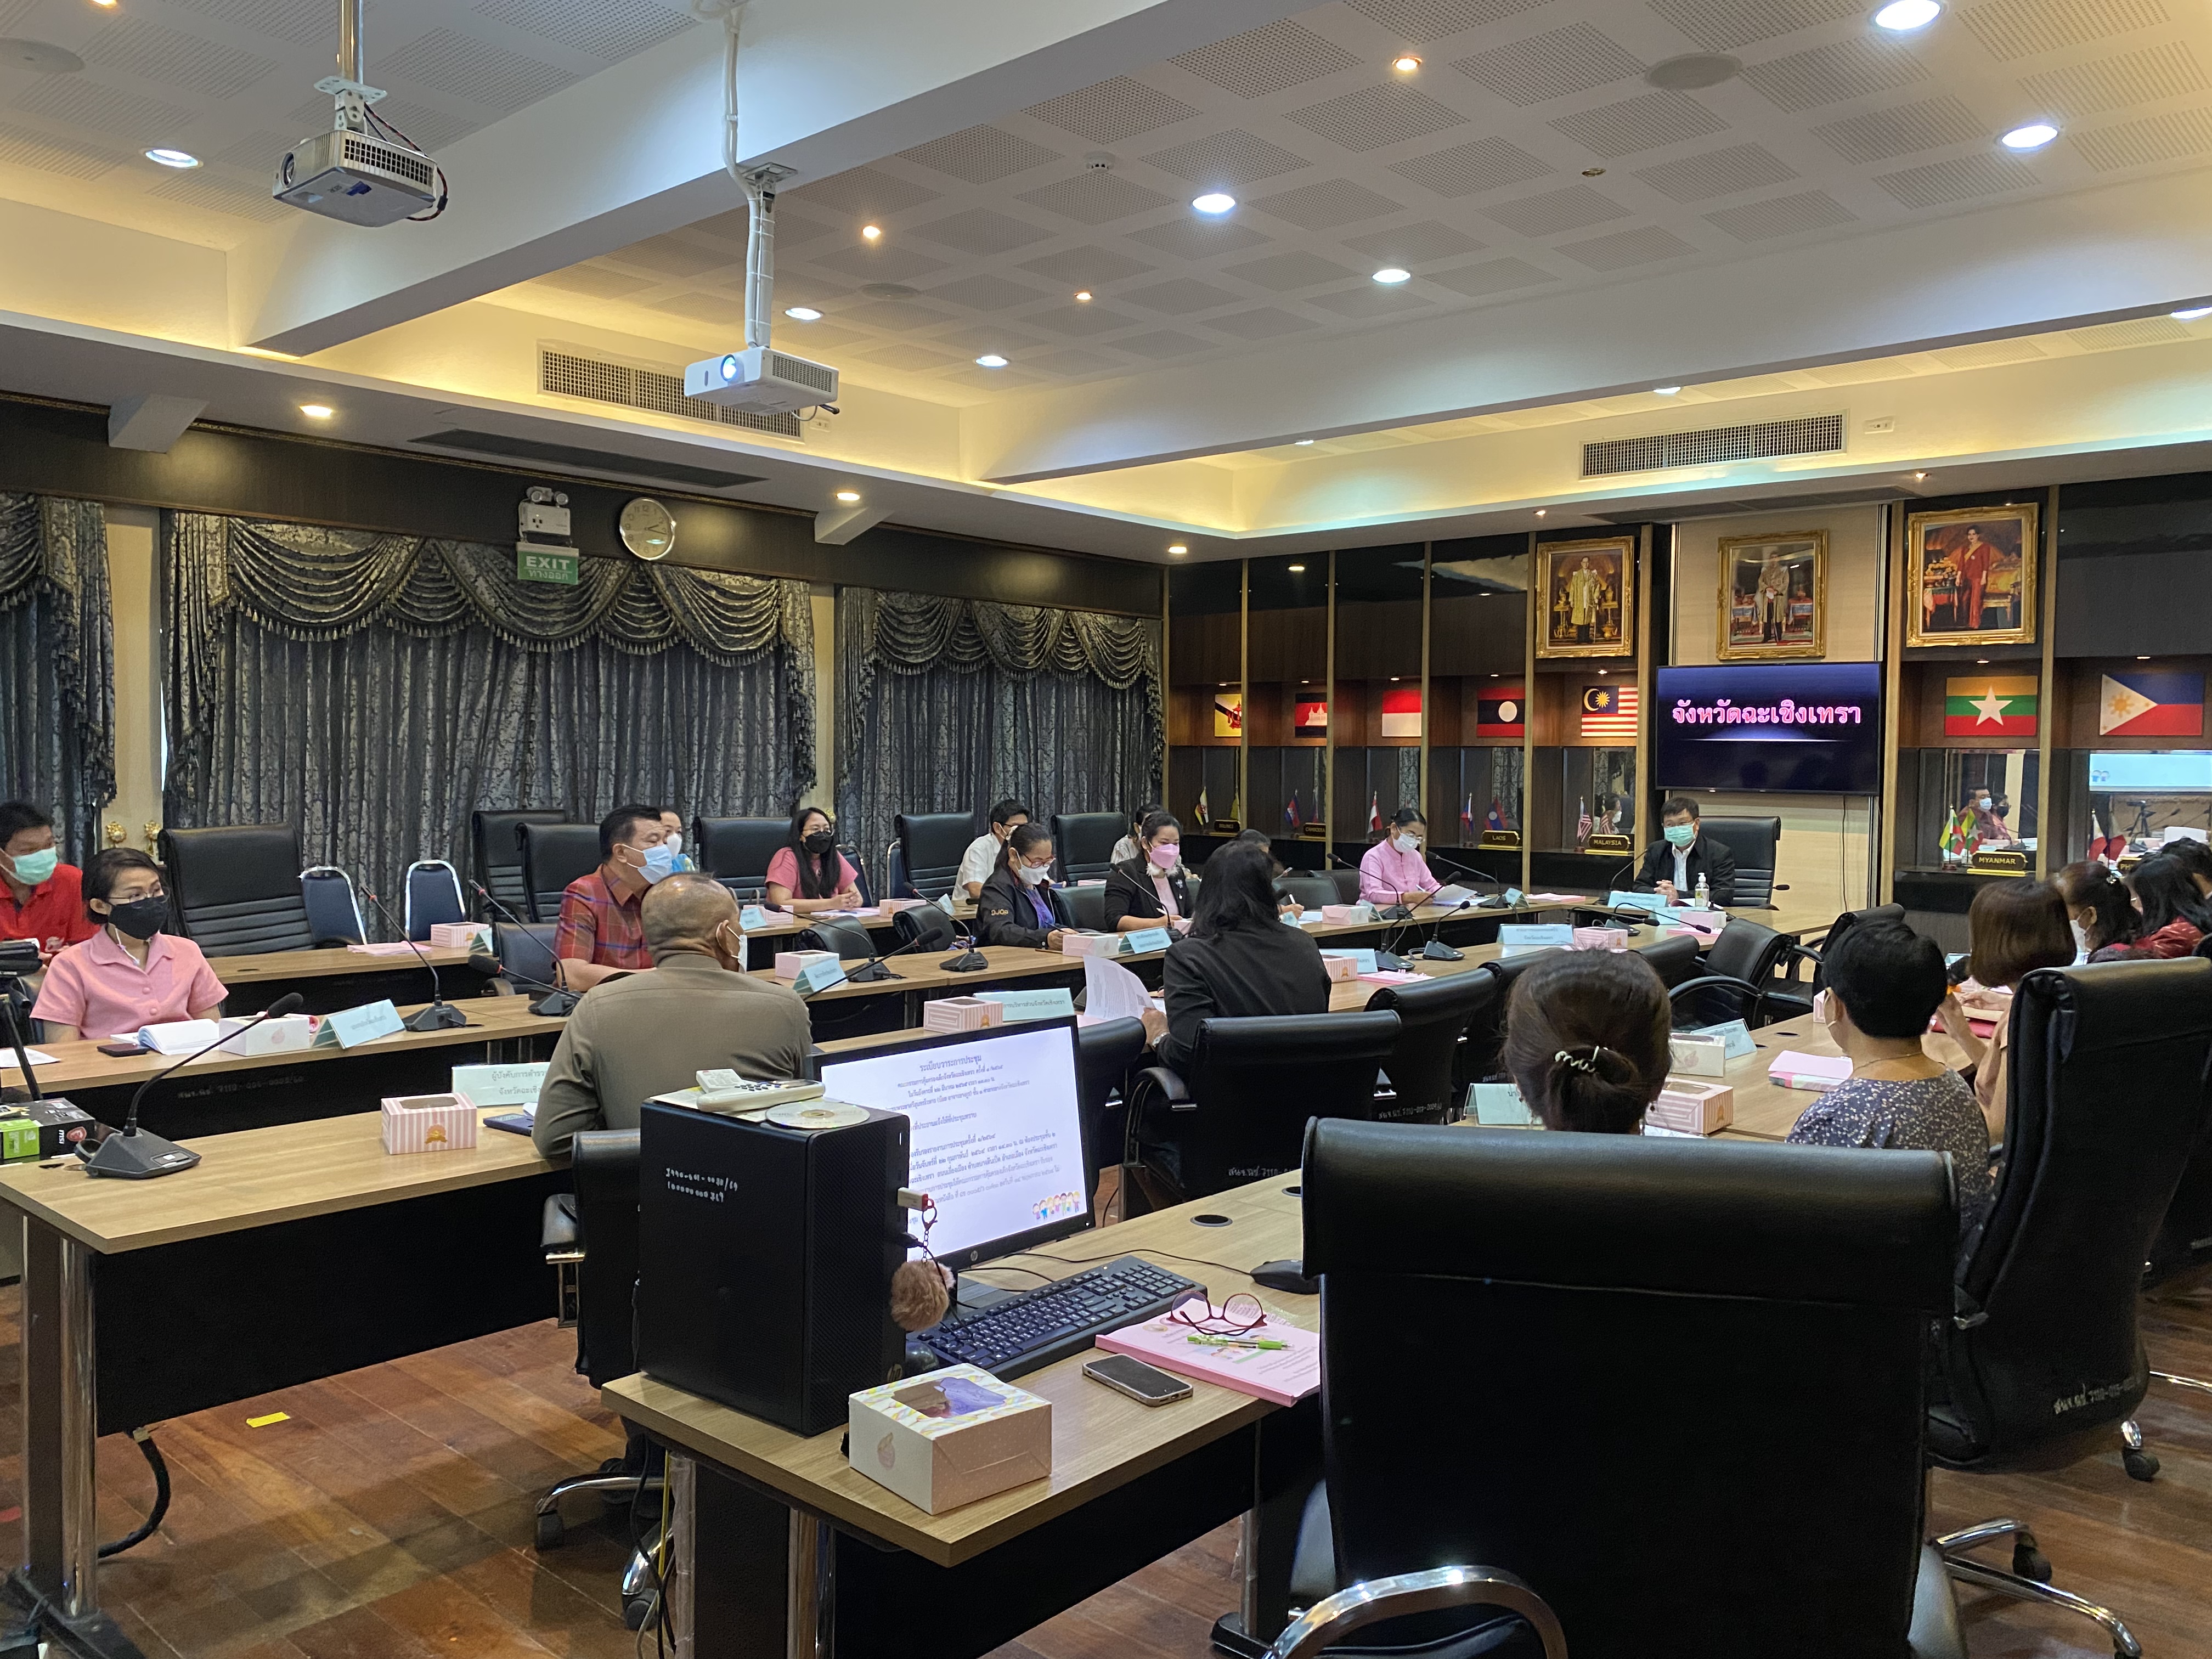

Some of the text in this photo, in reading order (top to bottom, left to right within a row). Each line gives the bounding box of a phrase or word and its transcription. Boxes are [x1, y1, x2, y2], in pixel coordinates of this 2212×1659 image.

[526, 556, 570, 570] EXIT
[528, 570, 568, 580] ทางออก
[1672, 698, 1861, 724] จังหวัดฉะเชิงเทรา
[1978, 857, 2016, 865] MYANMAR
[919, 1054, 981, 1071] ระเบียบวาระการประชุม
[492, 1069, 547, 1081] ผู้บังคับการตำรว
[499, 1086, 540, 1095] จังหวัดฉะเชิง
